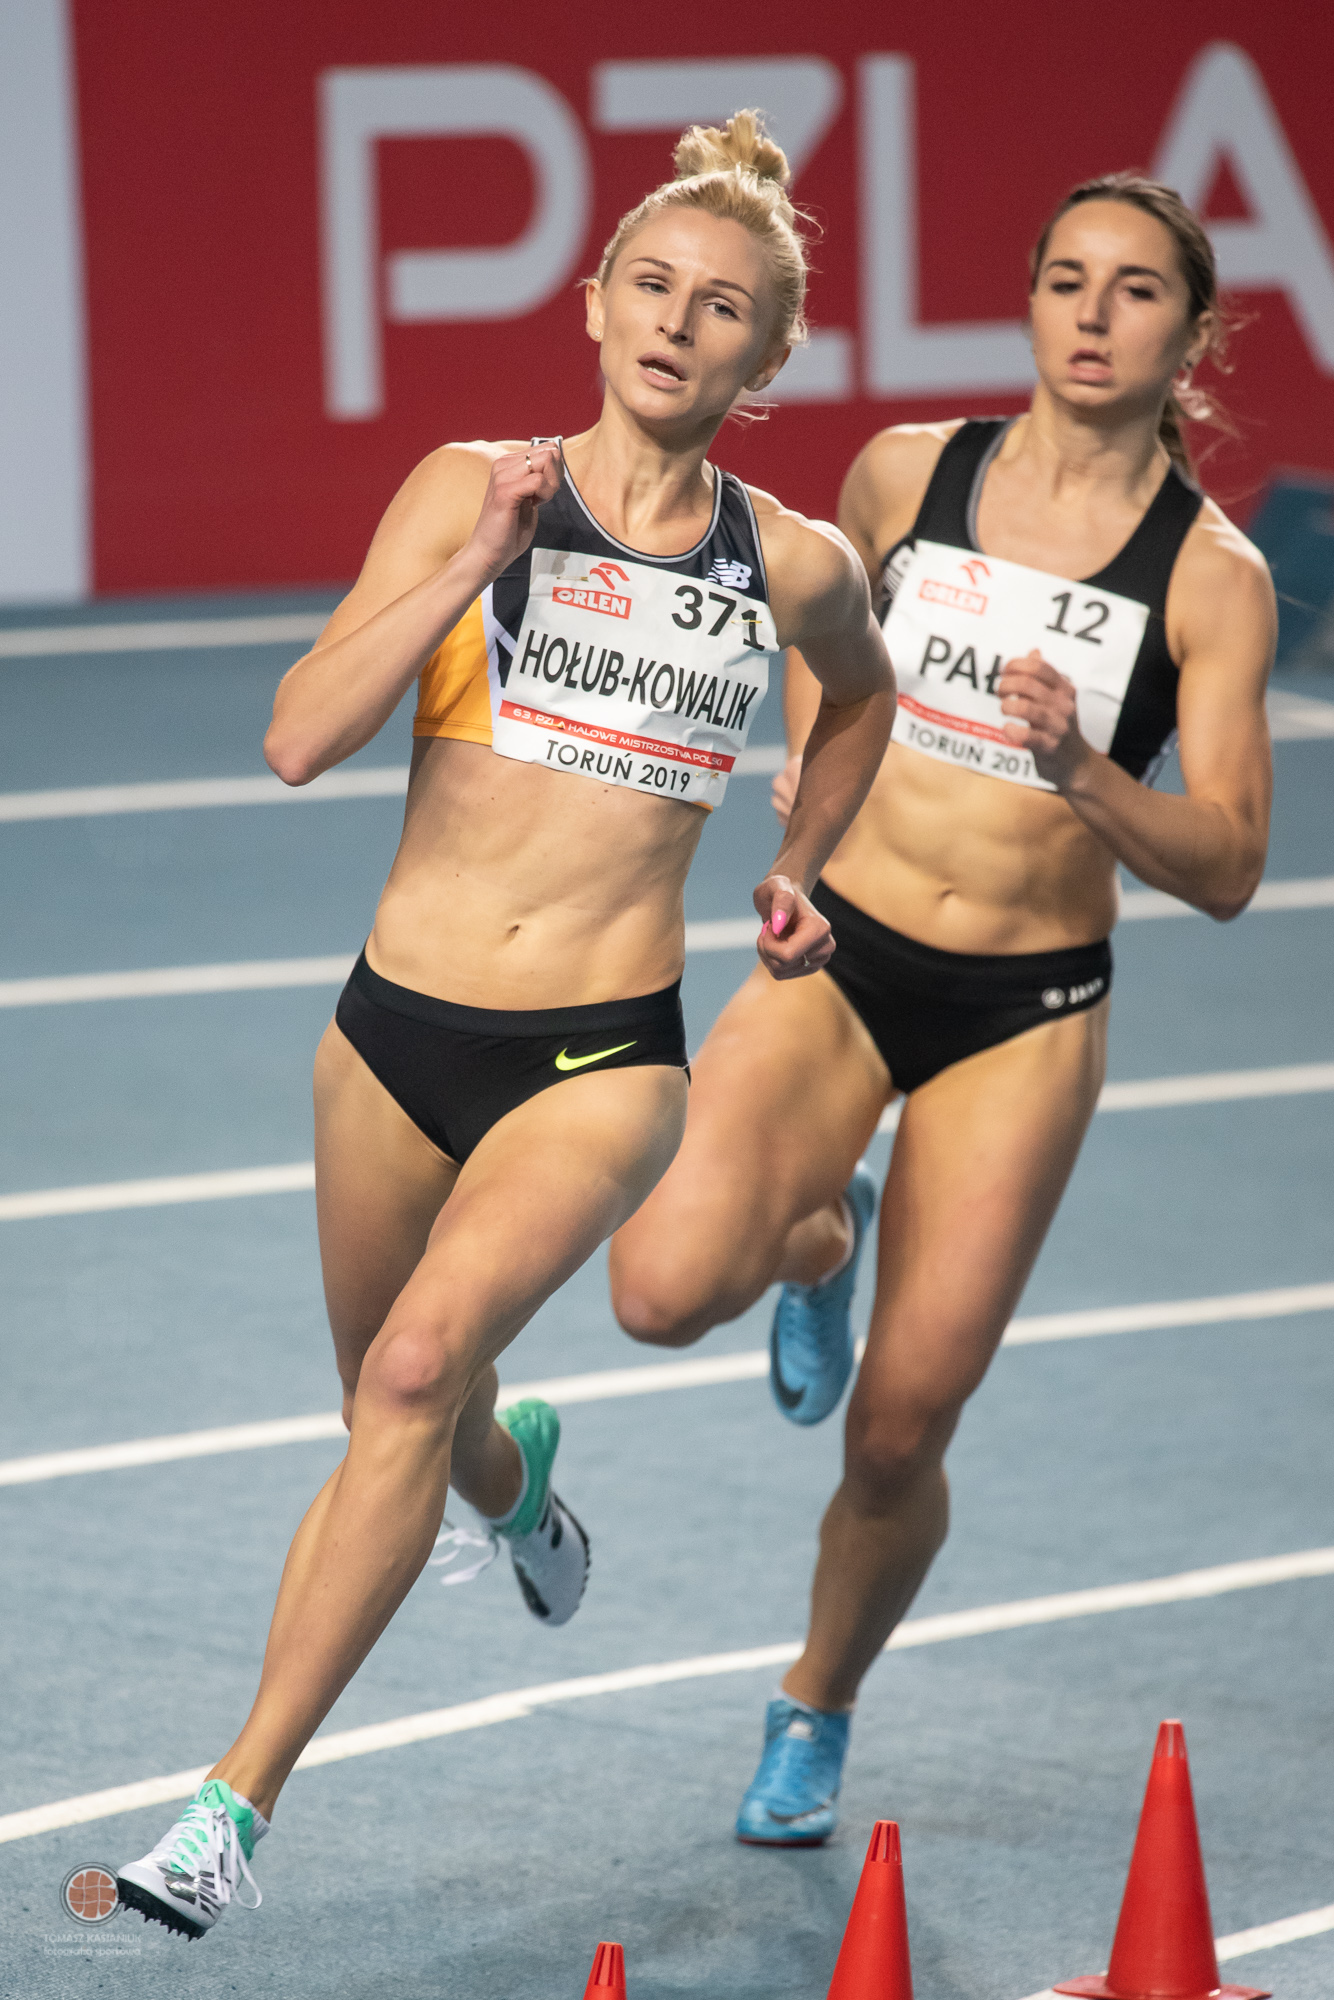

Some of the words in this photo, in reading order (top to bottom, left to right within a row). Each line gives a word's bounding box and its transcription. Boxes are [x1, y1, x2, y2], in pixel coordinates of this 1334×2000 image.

[316, 42, 1334, 422] PZLA
[555, 588, 629, 617] ORLEN
[671, 584, 766, 652] 371
[1045, 591, 1111, 646] 12
[519, 629, 759, 731] HOŁUB-KOWALIK
[919, 634, 1004, 697] PAŁ
[512, 707, 533, 721] 63.
[535, 713, 566, 729] PZLA
[568, 723, 618, 743] HALOWE
[618, 736, 692, 760] MISTRZOSTWA
[546, 738, 633, 781] TORUŃ
[638, 763, 691, 793] 2019
[991, 752, 1033, 777] 201
